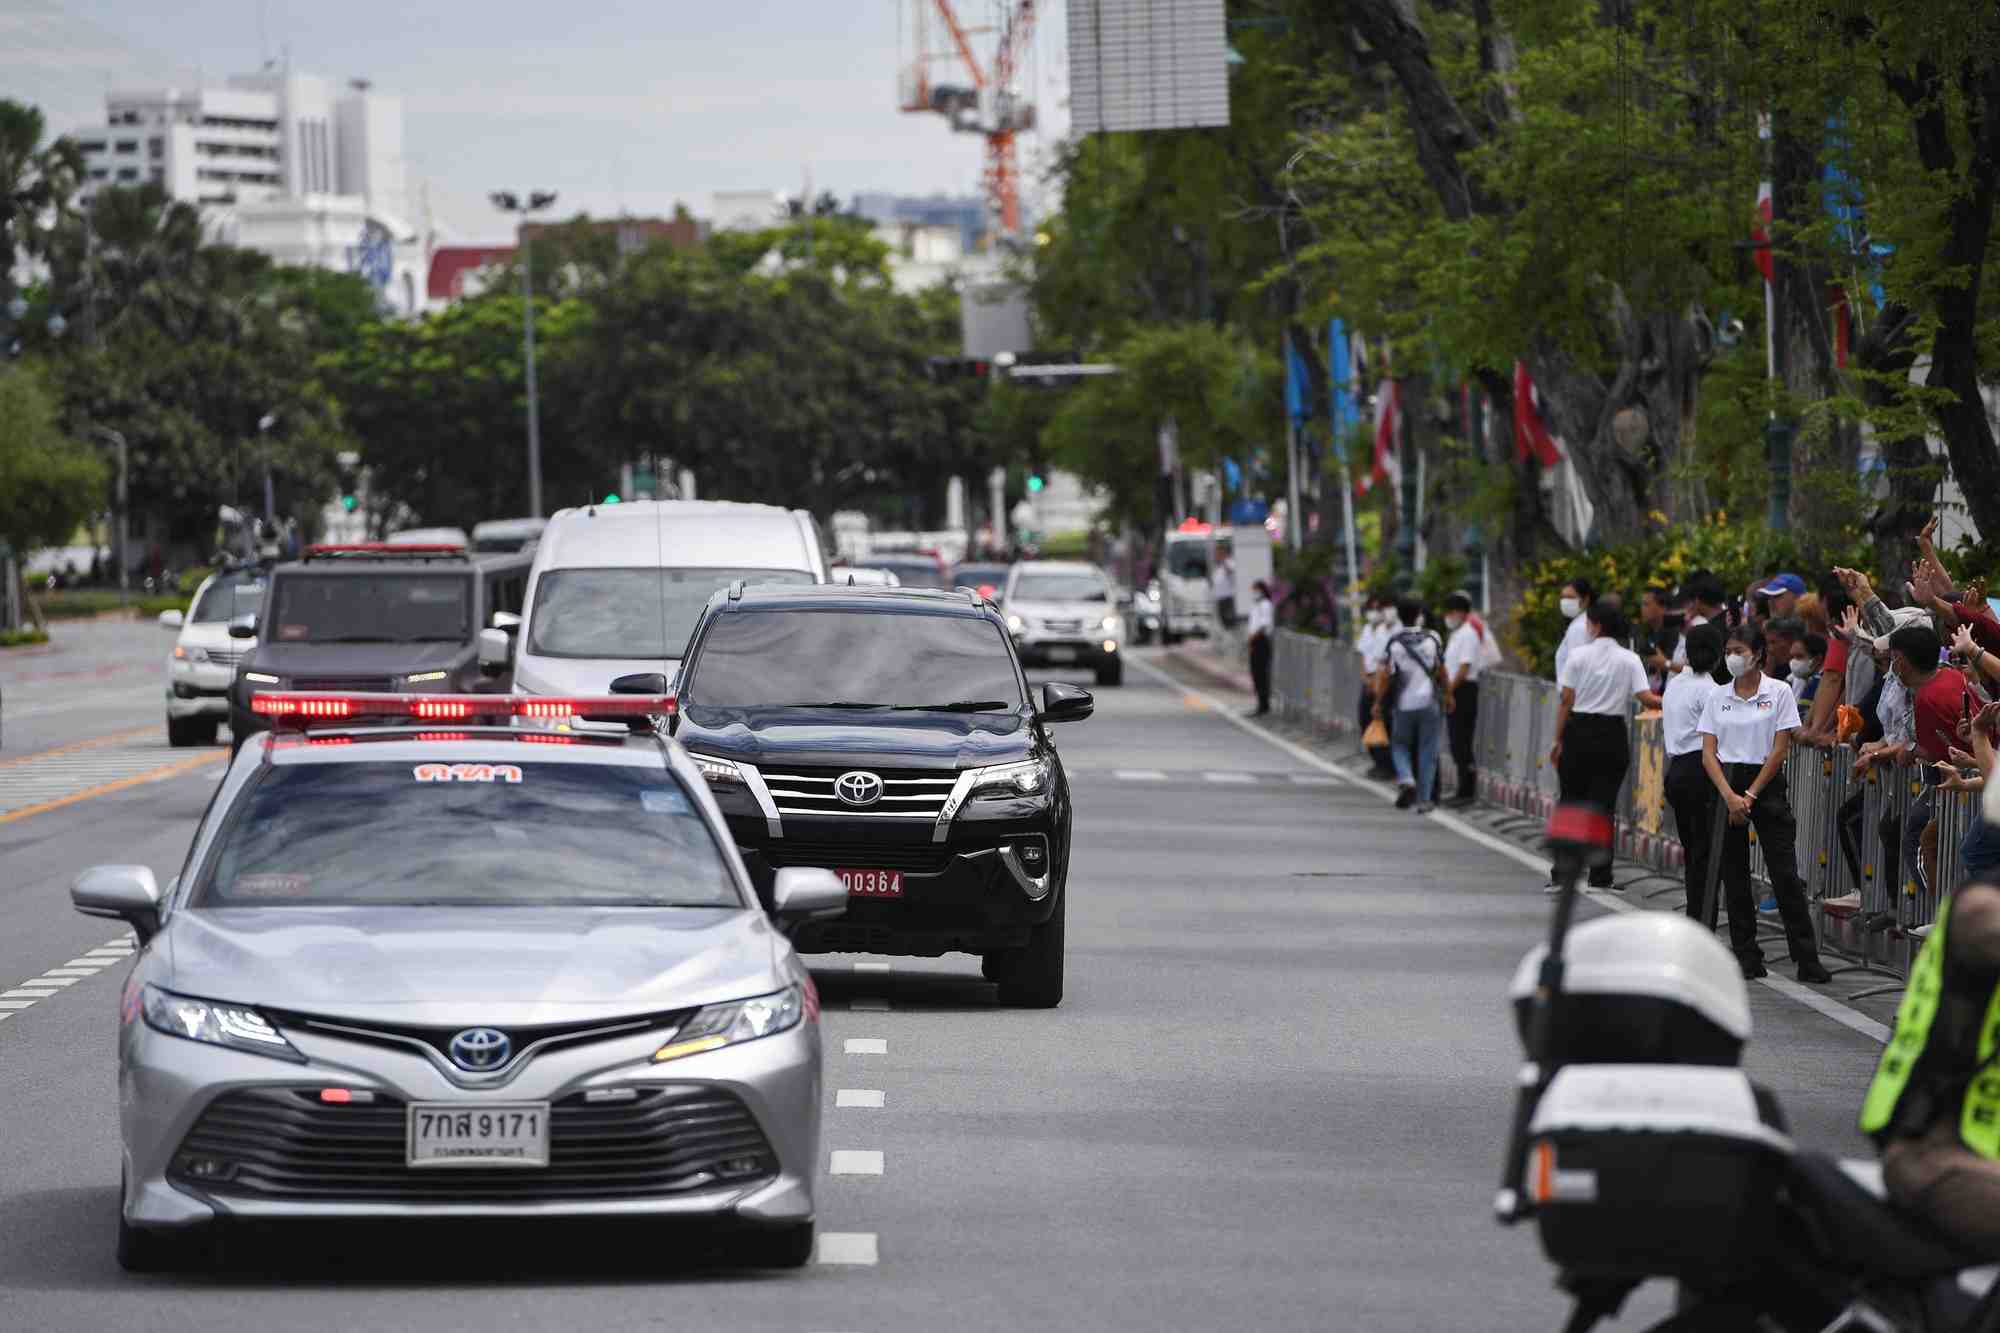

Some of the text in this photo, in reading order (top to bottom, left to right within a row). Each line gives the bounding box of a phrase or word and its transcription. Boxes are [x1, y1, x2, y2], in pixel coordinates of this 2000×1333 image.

[842, 871, 900, 893] 00364
[420, 1112, 537, 1138] 7กส 9171
